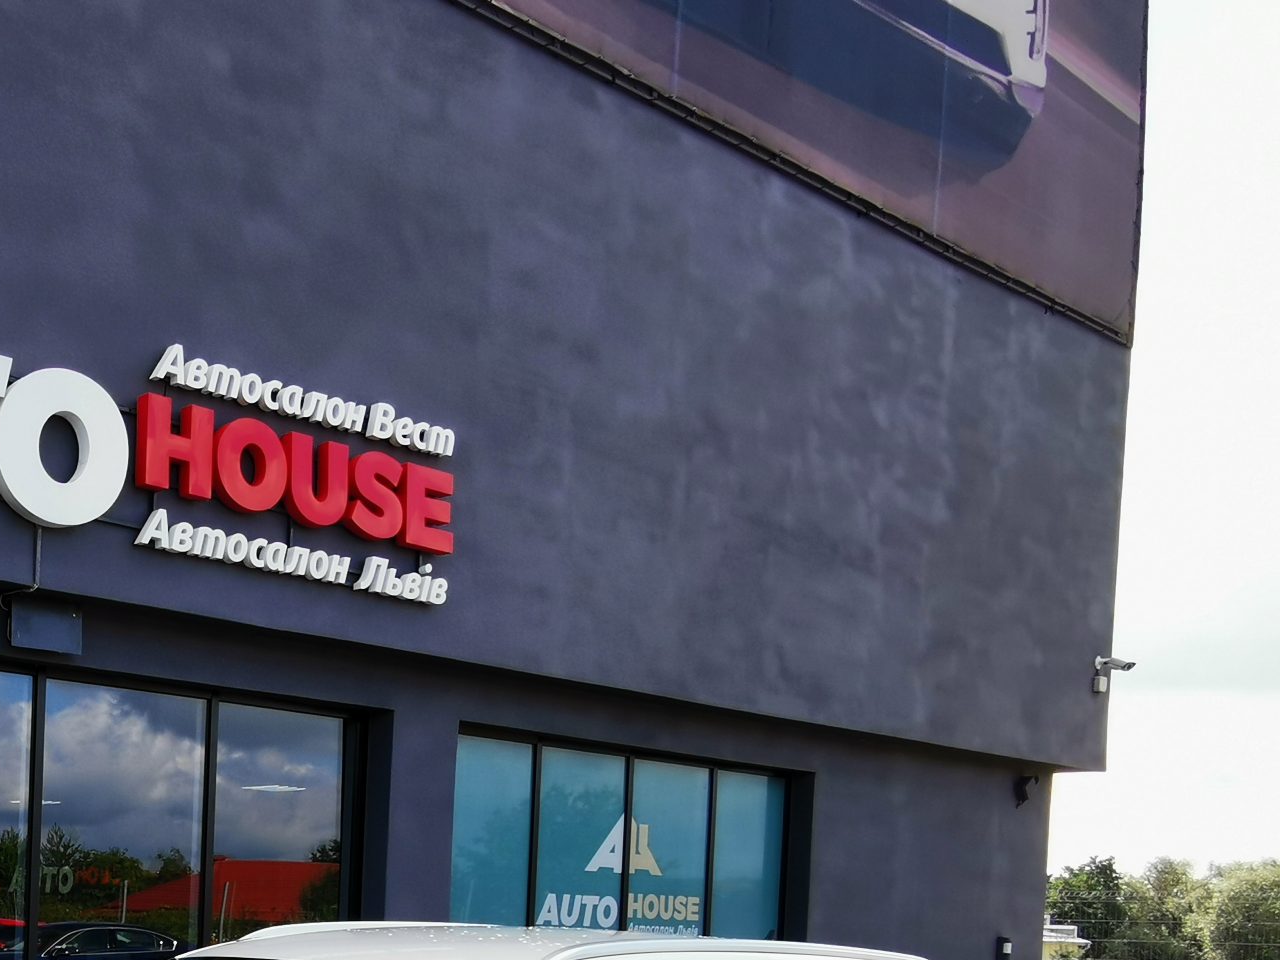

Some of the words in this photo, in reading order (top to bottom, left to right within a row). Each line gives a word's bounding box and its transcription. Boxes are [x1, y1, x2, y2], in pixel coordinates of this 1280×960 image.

[149, 344, 366, 433] Автосалон
[365, 402, 455, 457] Вест
[135, 392, 455, 555] HOUSE
[133, 508, 351, 585] Автосалон
[353, 556, 448, 605] Львів
[536, 893, 618, 928] AUTO
[627, 893, 700, 921] HOUSE
